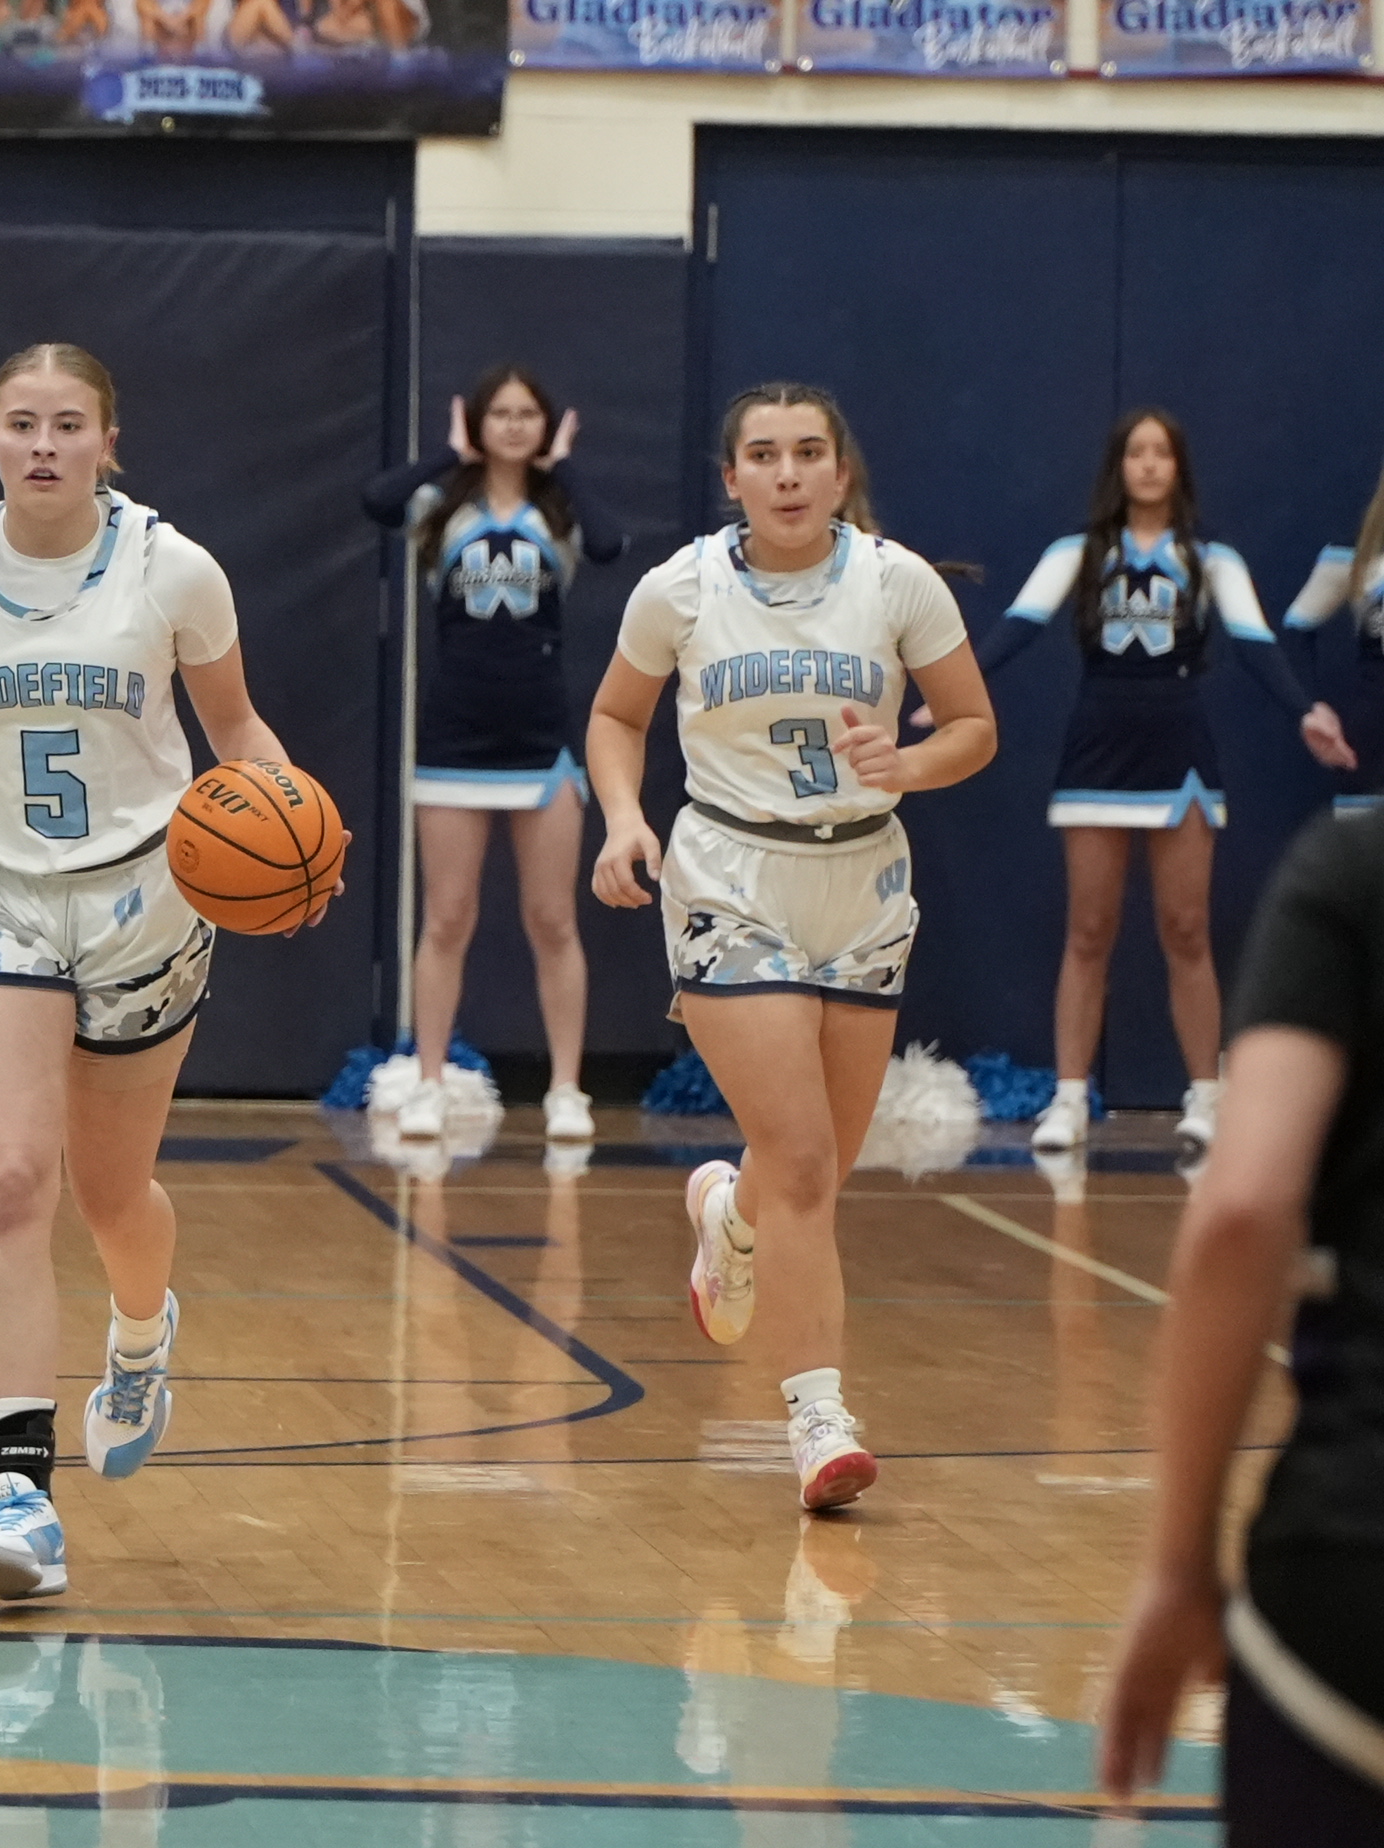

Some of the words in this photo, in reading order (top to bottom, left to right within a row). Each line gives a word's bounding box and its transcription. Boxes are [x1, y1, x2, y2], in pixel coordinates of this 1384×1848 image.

[700, 649, 885, 712] WIDEFIELD
[20, 728, 90, 839] 5
[769, 717, 838, 799] 3
[195, 777, 252, 815] EVO
[0, 1446, 44, 1456] ZAMST
